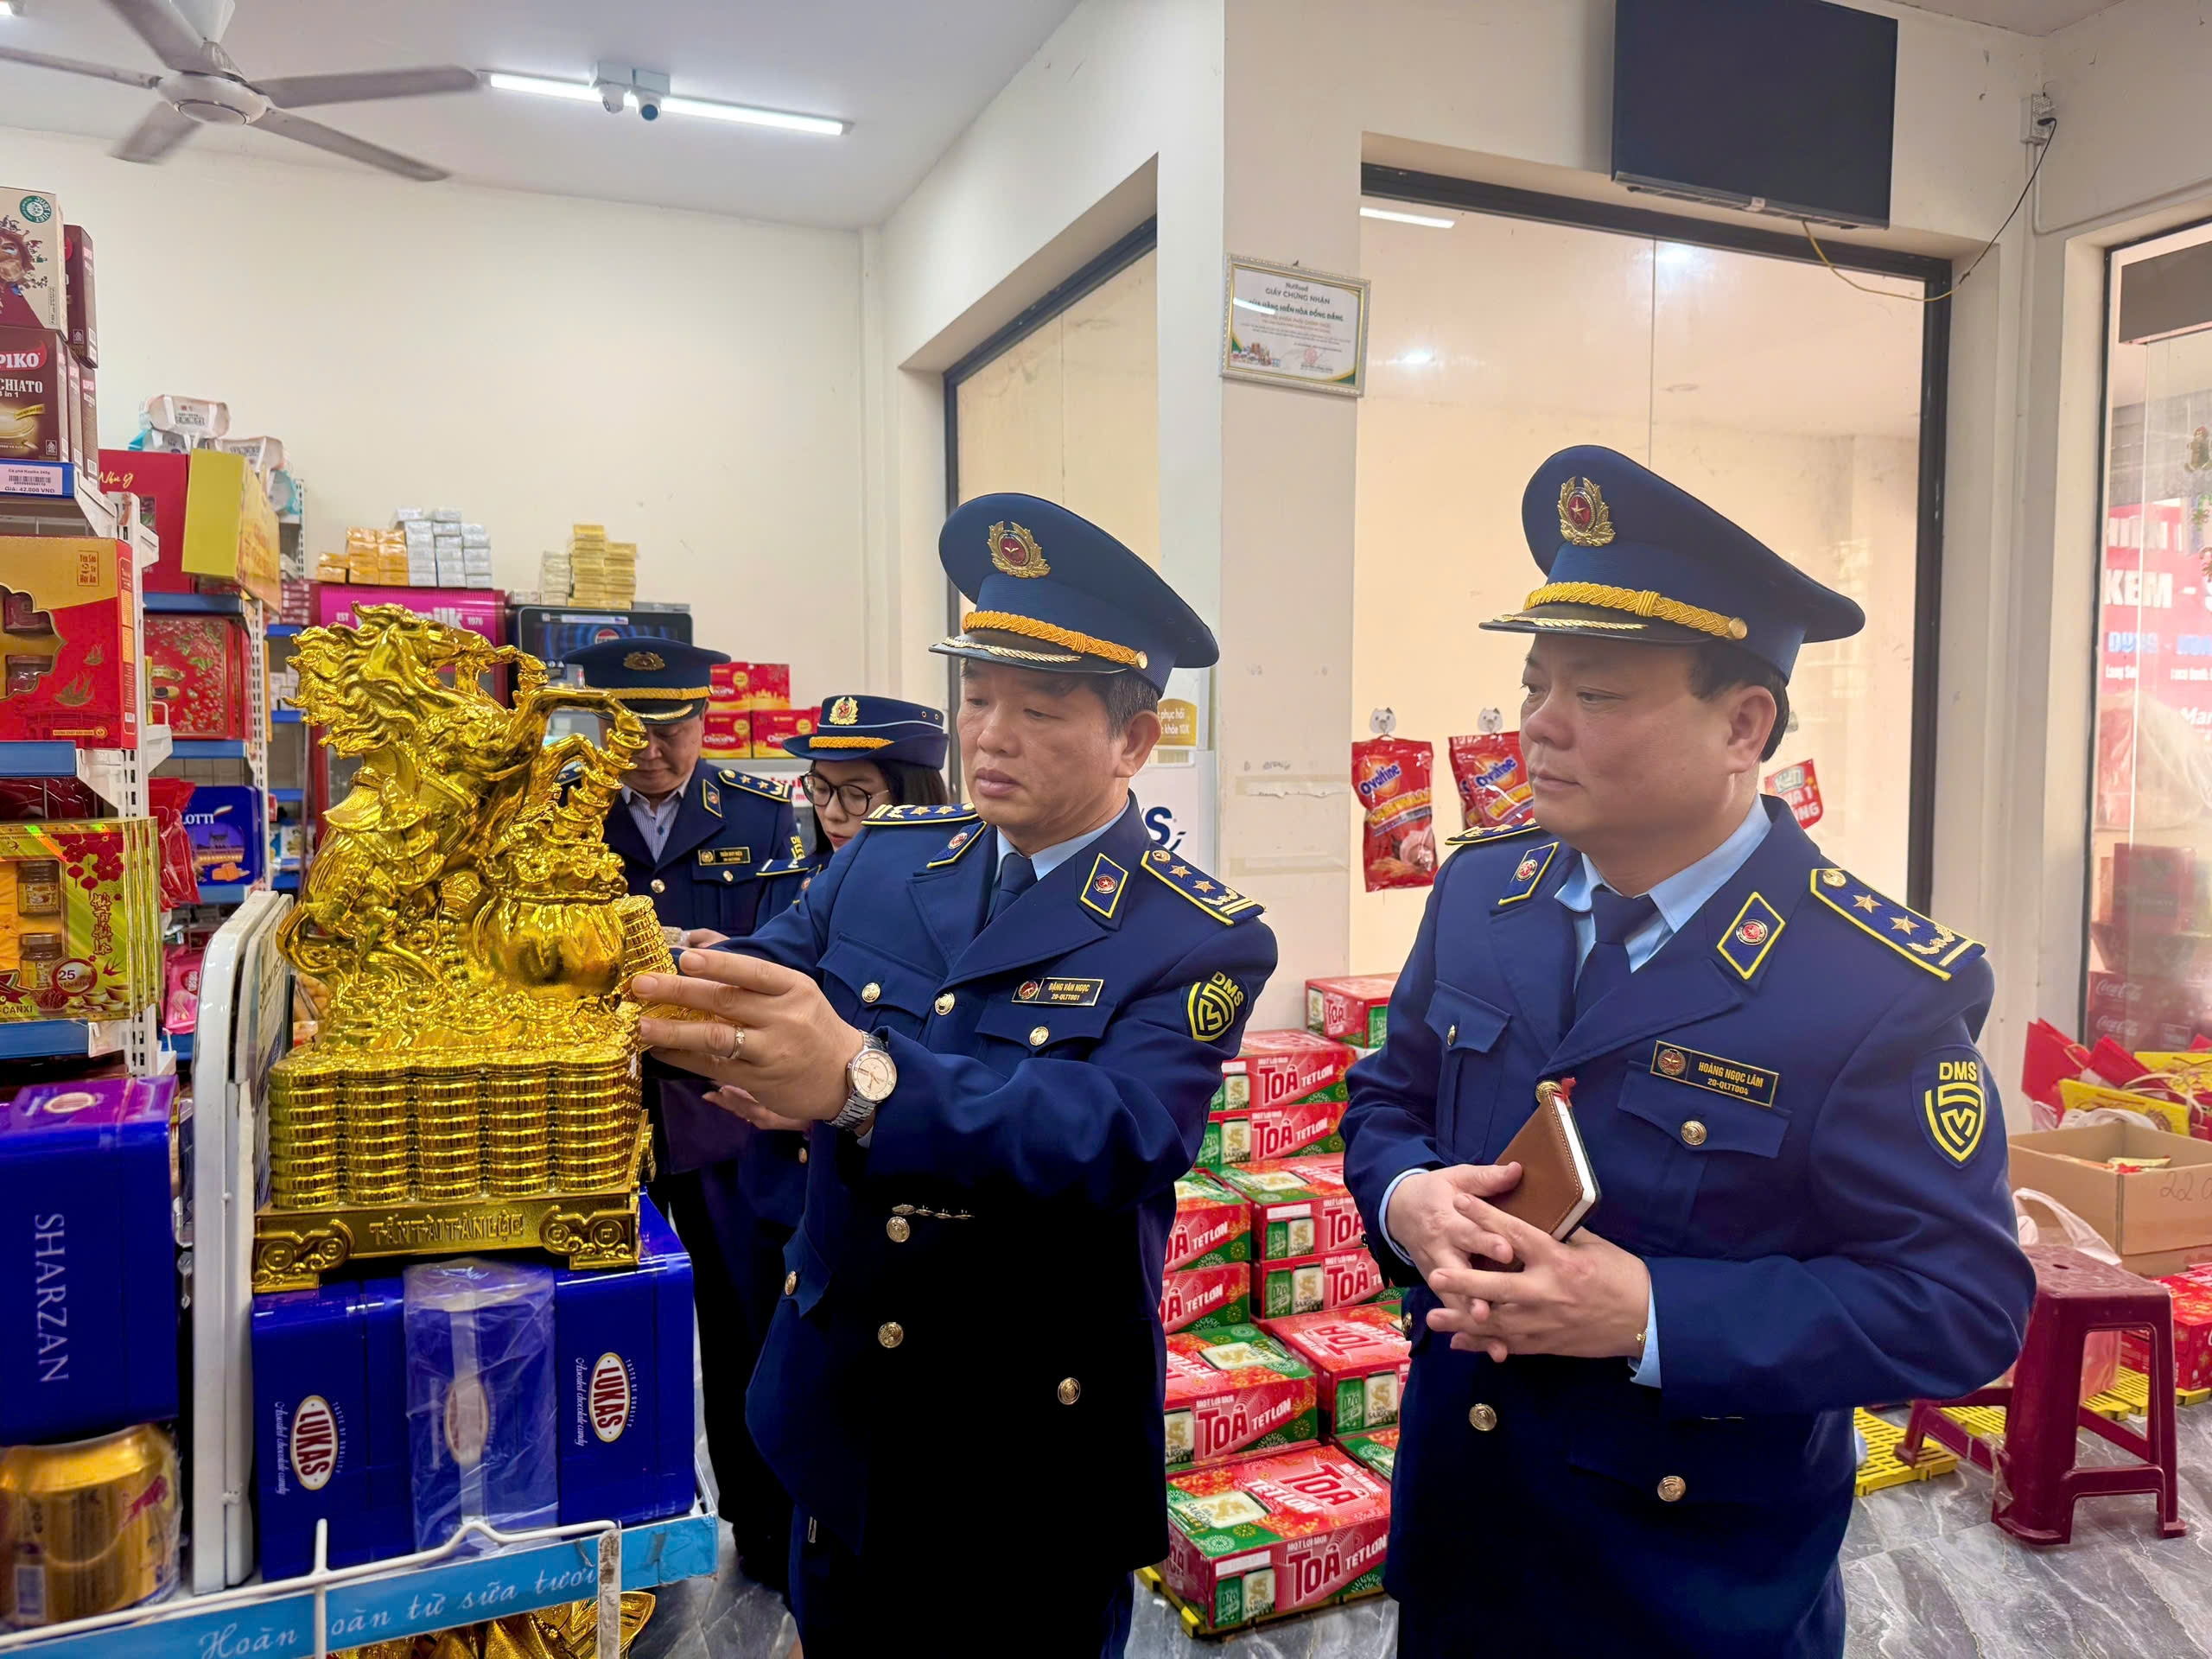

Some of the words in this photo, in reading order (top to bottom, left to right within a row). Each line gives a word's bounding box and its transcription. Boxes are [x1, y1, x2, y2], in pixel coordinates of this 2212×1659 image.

[2105, 569, 2173, 609] KEM
[1359, 763, 1402, 796] Ovaltine
[58, 969, 76, 981] 25
[1211, 970, 1244, 1007] DMS
[1698, 1061, 1725, 1077] HOÀNG
[1725, 1068, 1746, 1084] NGỌC
[1746, 1074, 1764, 1088] LÂM
[1707, 1077, 1749, 1096] 20-QLTT004
[1938, 1061, 1978, 1083] DMS
[35, 1213, 69, 1382] SHARZAN
[593, 1366, 626, 1429] LUKAS
[296, 1409, 333, 1476] LUKAS
[198, 1623, 297, 1659] Hoàn
[330, 1608, 391, 1637] oàn
[406, 1591, 446, 1622] từ
[461, 1580, 518, 1612] sữa
[535, 1565, 597, 1597] tươi
